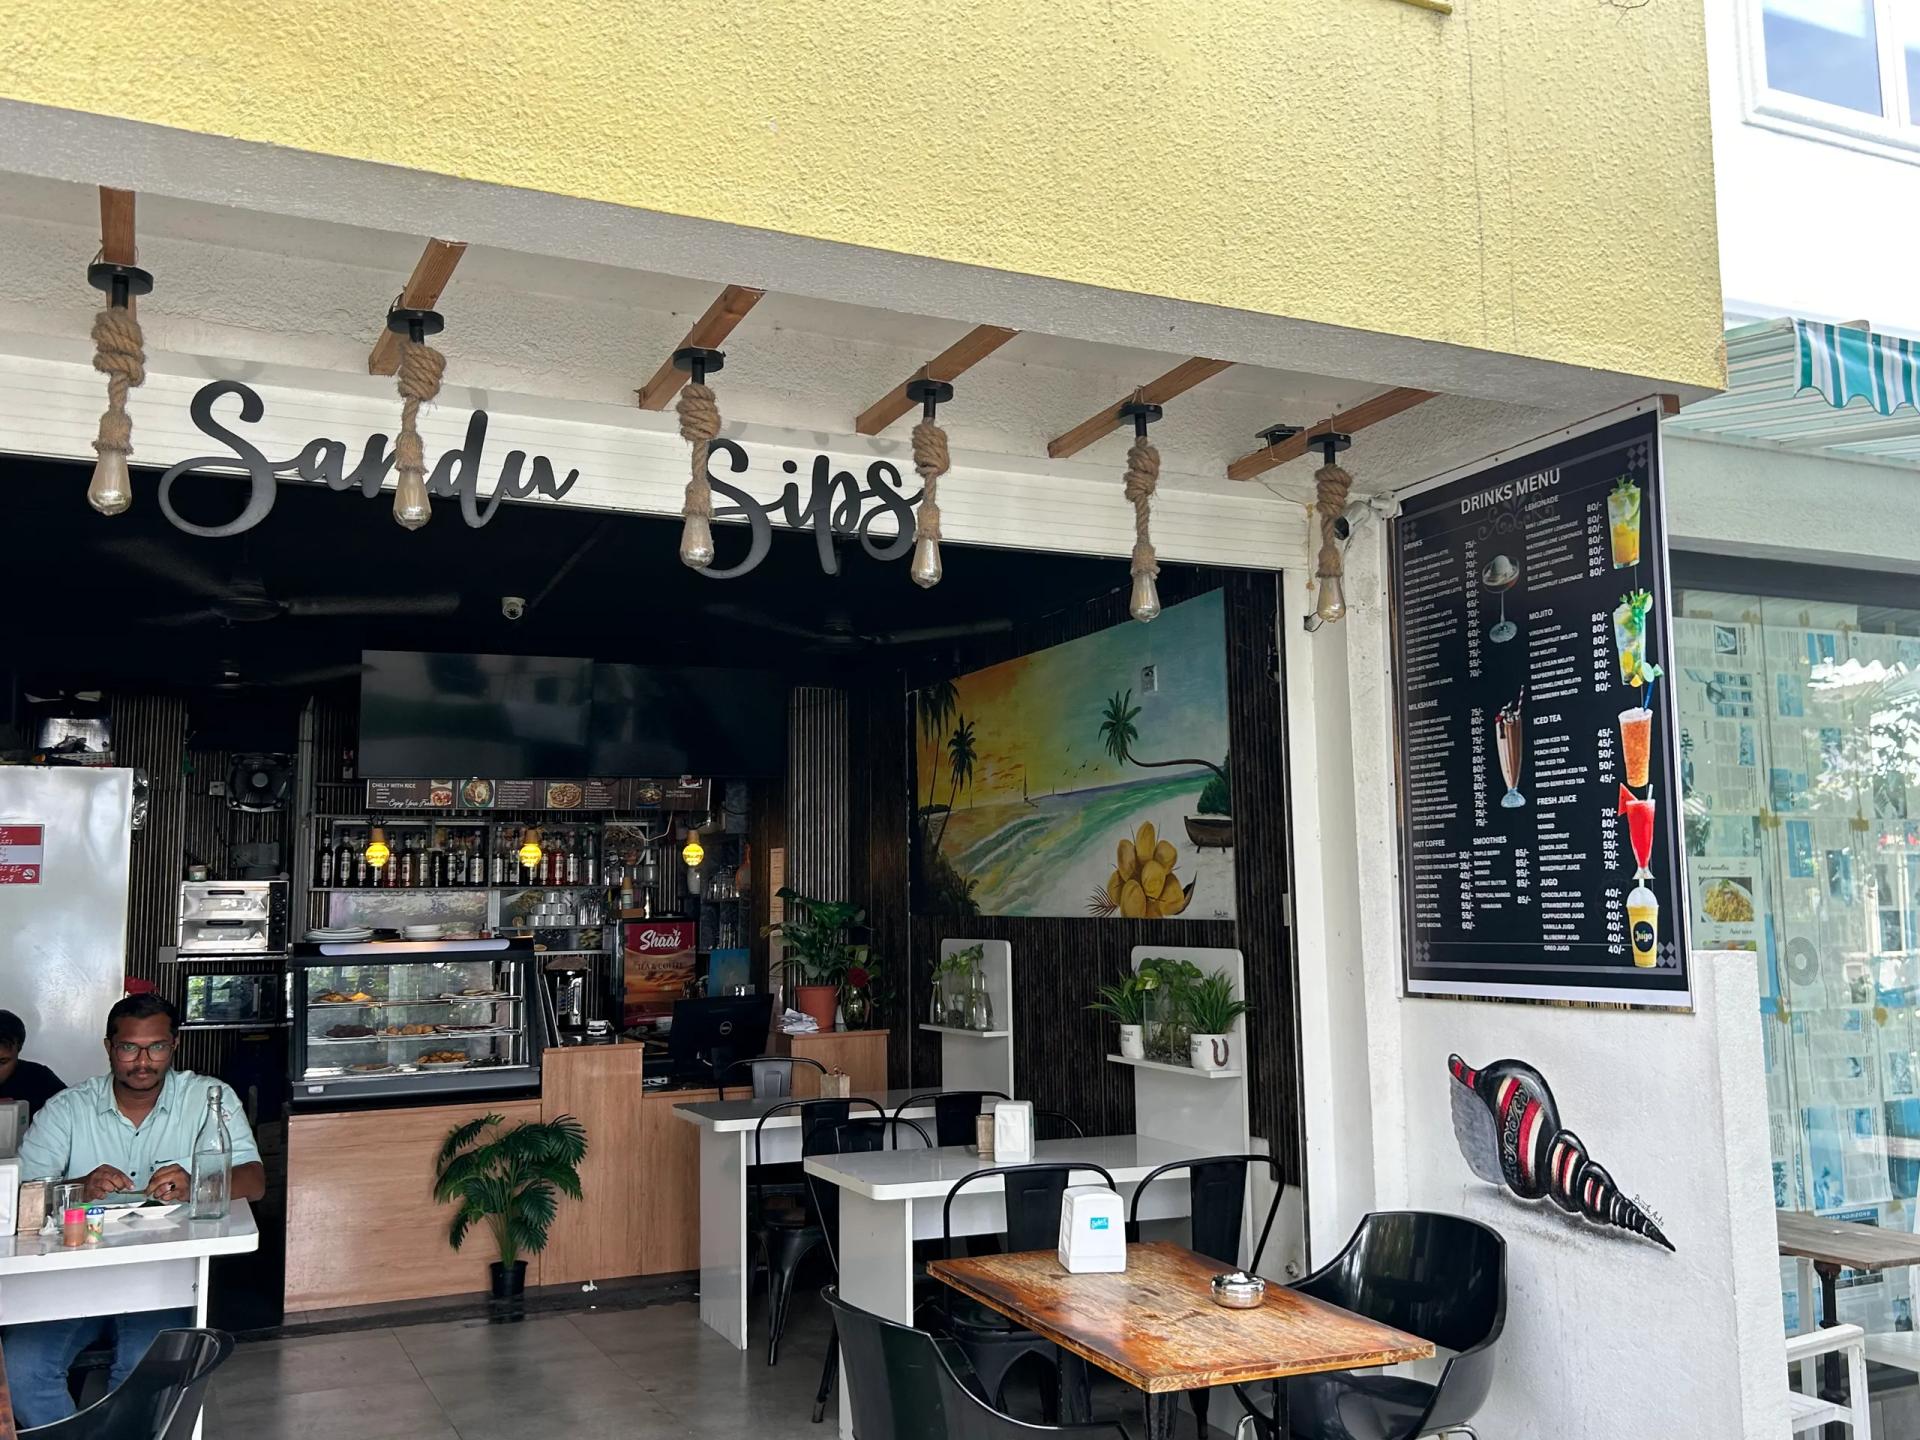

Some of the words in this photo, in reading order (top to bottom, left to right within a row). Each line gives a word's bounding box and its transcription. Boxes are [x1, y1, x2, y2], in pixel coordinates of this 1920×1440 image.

[158, 380, 579, 537] Sandu
[696, 438, 924, 579] Sips
[1461, 485, 1513, 515] DRINKS
[1516, 468, 1561, 497] MENU
[1525, 494, 1559, 512] LEMONADE
[1586, 501, 1602, 514] 80/-
[1587, 514, 1603, 525] 80/-
[1587, 524, 1604, 536] 80/-
[1404, 539, 1423, 551] DRINKS
[1588, 534, 1604, 546] 80/-
[1588, 545, 1604, 557] 80/-
[1588, 556, 1605, 567] 80/-
[1589, 567, 1606, 578] 80/-
[1529, 608, 1553, 620] MOJITO
[1591, 612, 1608, 623] 80/-
[1592, 623, 1609, 634] 80/-
[1592, 635, 1609, 646] 80/-
[1593, 648, 1610, 658] 80/-
[1594, 659, 1610, 670] 80/-
[1594, 671, 1611, 682] 80/-
[1594, 683, 1612, 693] 80/-
[1408, 699, 1438, 711] MILKSHAKE
[1533, 716, 1548, 725] ICED
[1549, 714, 1562, 723] TEA
[1597, 727, 1614, 739] 45/-
[1598, 738, 1614, 748] 45/-
[1598, 748, 1615, 760] 50/-
[1598, 760, 1615, 771] 50/-
[1599, 773, 1616, 784] 45/-
[1537, 796, 1557, 806] FRESH
[1558, 794, 1577, 804] JUICE
[1601, 807, 1618, 818] 70/-
[1602, 818, 1618, 829] 80/-
[1602, 830, 1619, 840] 70/-
[1425, 839, 1445, 848] COFFEE
[1473, 836, 1507, 845] SMOOTHIES
[1602, 840, 1619, 850] 55/-
[1459, 851, 1472, 860] 30/-
[1515, 848, 1530, 858] 85/-
[1603, 850, 1620, 860] 70/-
[1460, 862, 1472, 870] 35/-
[1516, 858, 1530, 867] 85/-
[1603, 860, 1620, 870] 75/-
[1459, 871, 1473, 880] 40/-
[1516, 869, 1530, 878] 95/-
[1460, 882, 1473, 890] 45/-
[1516, 879, 1530, 888] 85/-
[1540, 878, 1558, 886] JUGO
[1460, 892, 1474, 900] 45/-
[1605, 888, 1622, 898] 40/-
[1517, 896, 1532, 904] 85/-
[1605, 900, 1623, 909] 40/-
[1461, 902, 1474, 910] 55/-
[1461, 911, 1475, 919] 55/-
[1606, 912, 1624, 921] 40/-
[1606, 923, 1624, 931] 40/-
[1607, 934, 1625, 943] 40/-
[1607, 945, 1625, 954] 40/-
